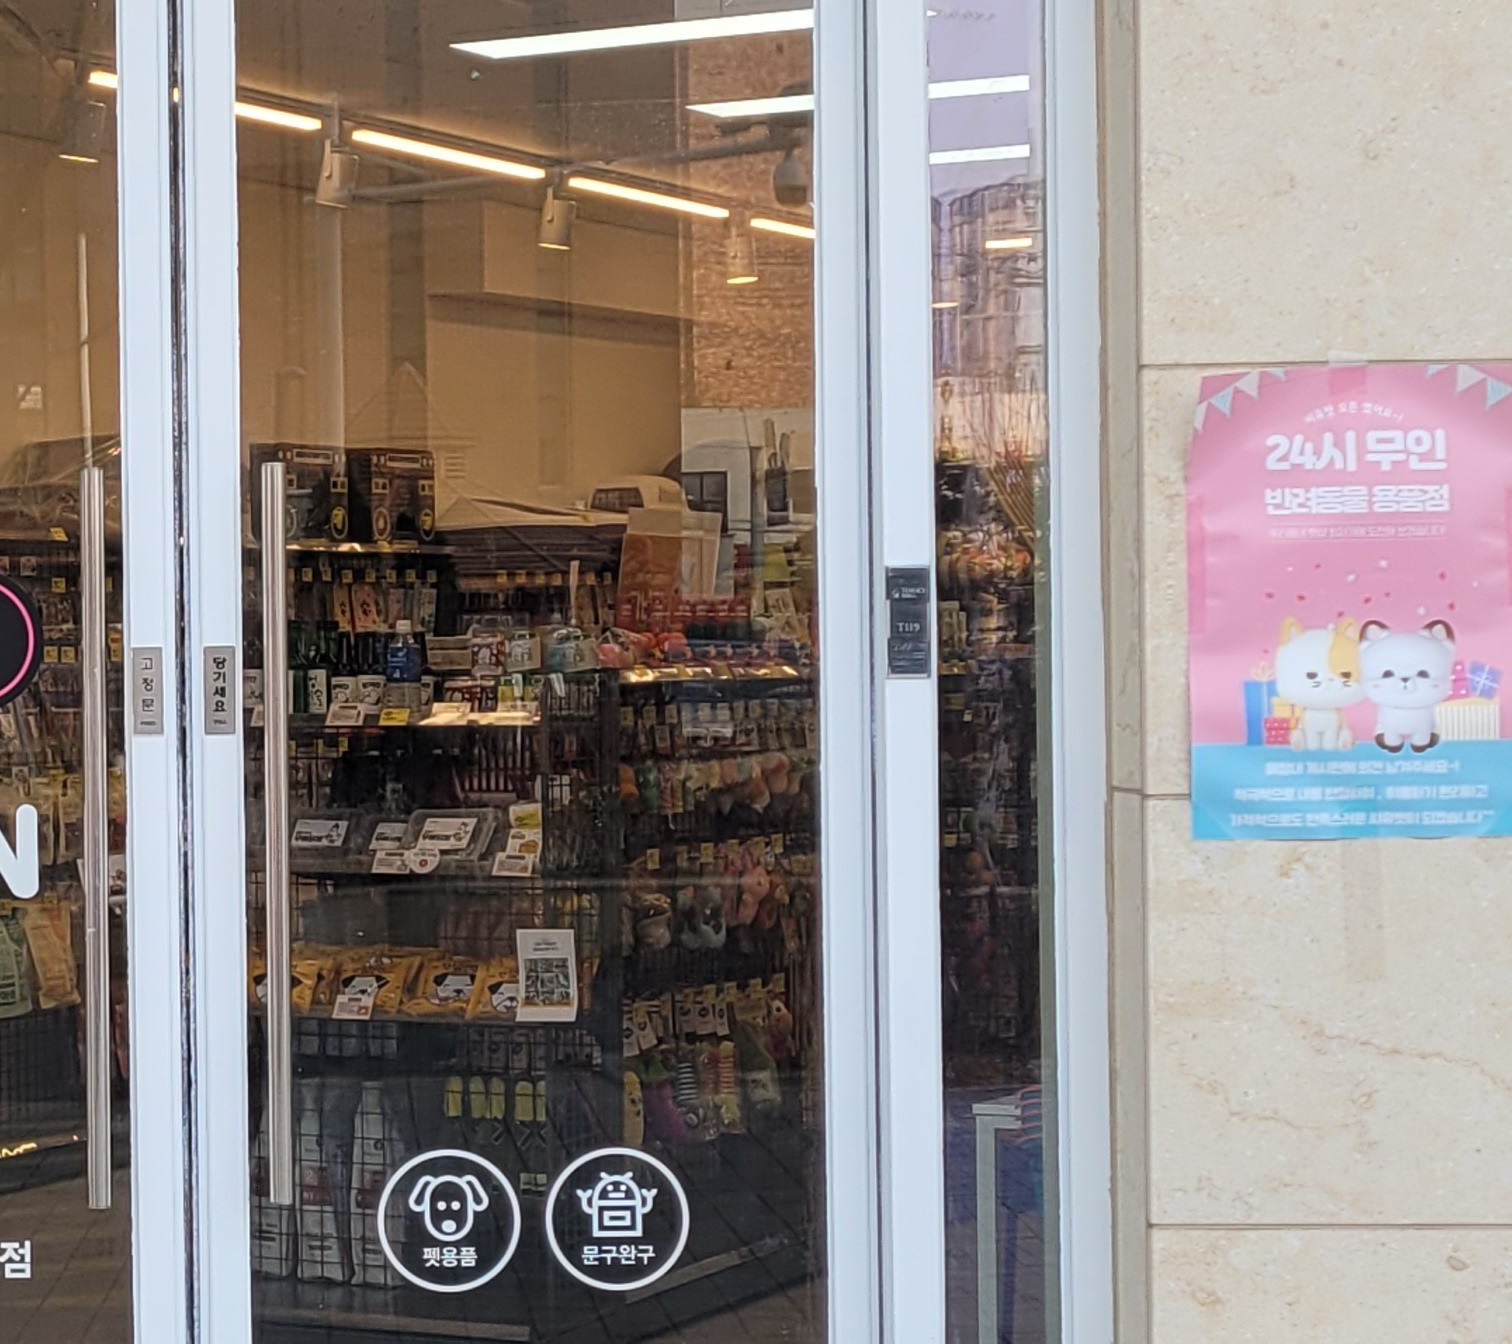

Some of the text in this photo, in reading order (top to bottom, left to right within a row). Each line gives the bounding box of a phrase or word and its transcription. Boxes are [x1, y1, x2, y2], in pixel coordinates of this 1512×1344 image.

[1265, 428, 1448, 471] 24시 무인
[1265, 484, 1450, 514] 반려동물 용품점
[213, 657, 227, 712] 당기세요
[423, 1247, 477, 1267] 펫용품
[582, 1245, 655, 1265] 문구완구
